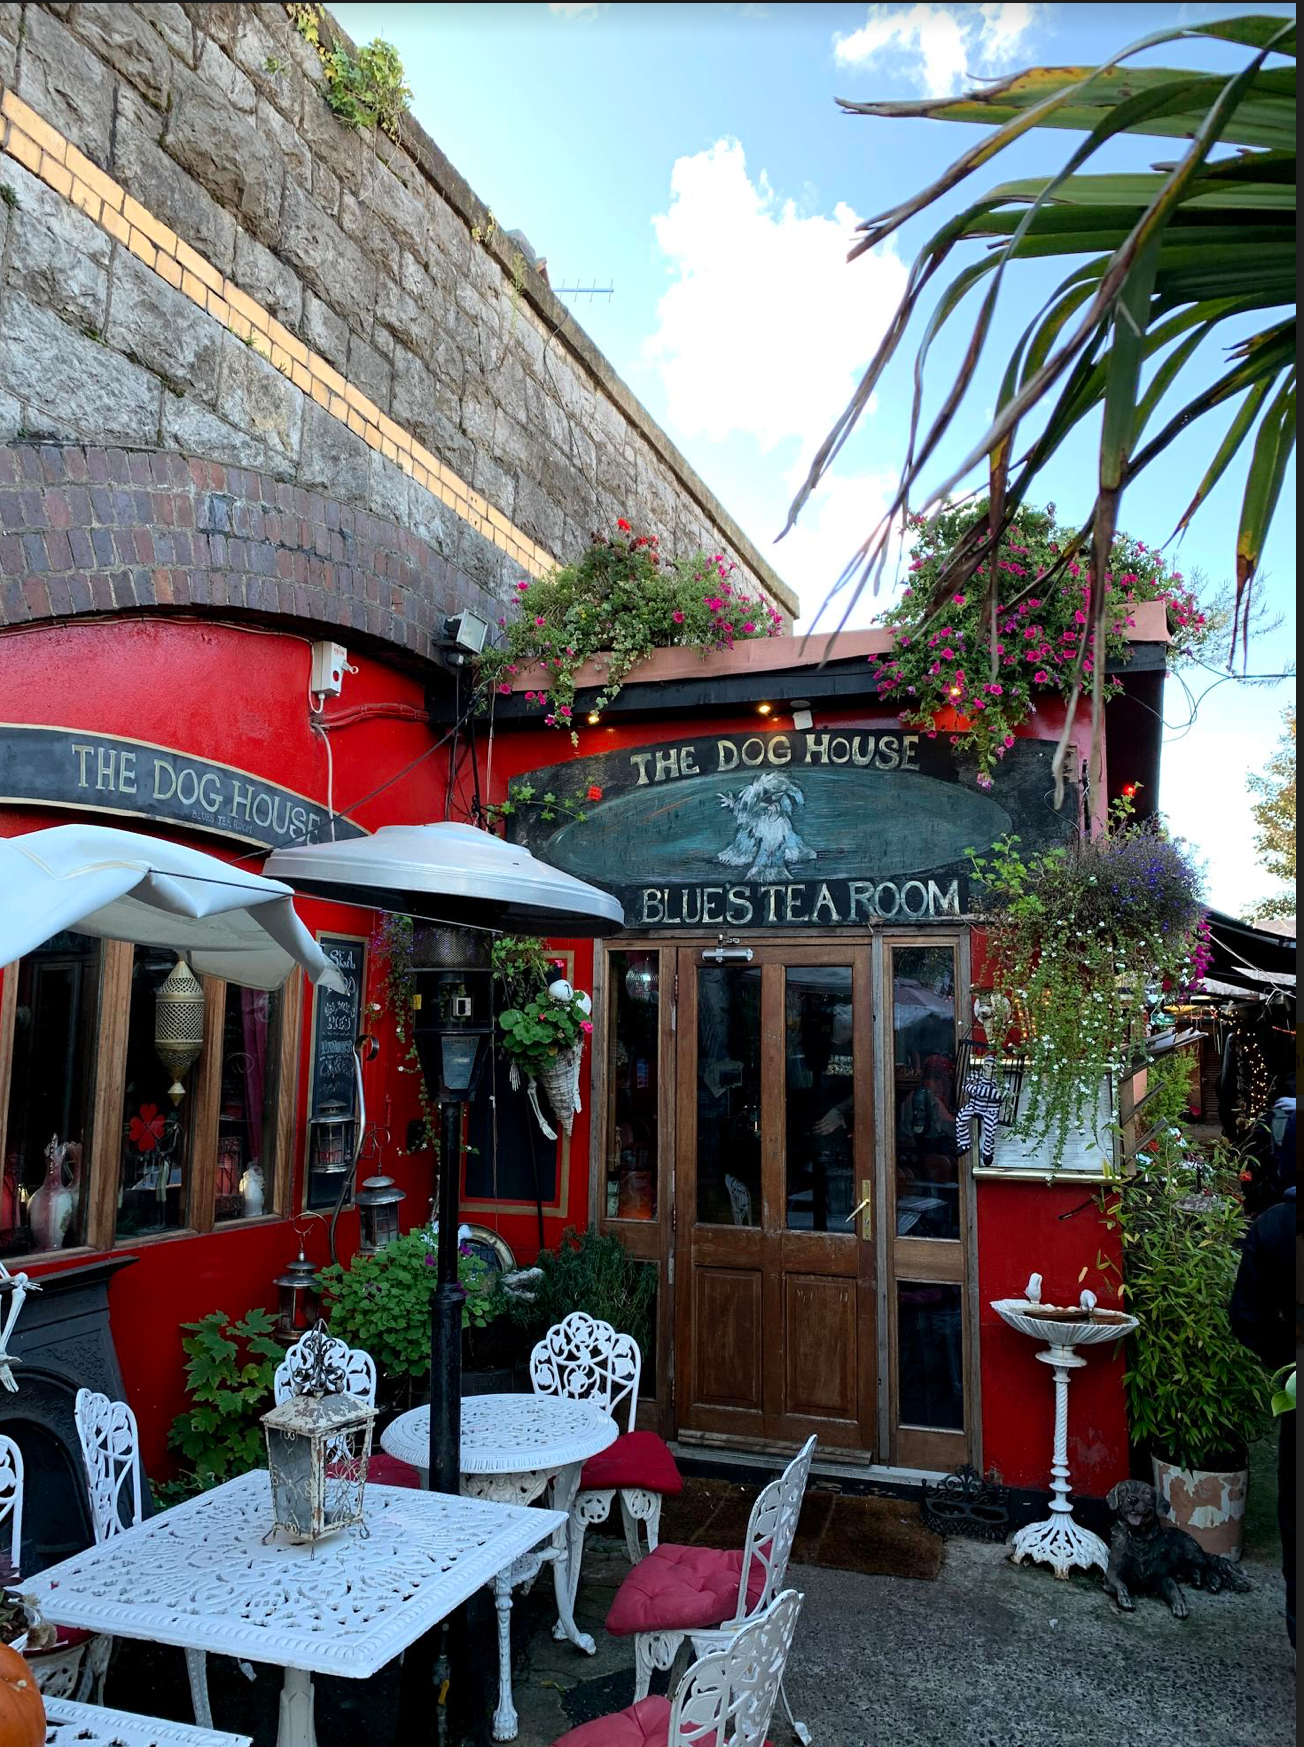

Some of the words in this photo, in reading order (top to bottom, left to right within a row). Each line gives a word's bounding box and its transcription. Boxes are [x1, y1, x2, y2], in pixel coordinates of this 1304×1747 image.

[630, 745, 700, 786] THE
[716, 735, 793, 772] DOG
[803, 733, 920, 771] HOUSE
[72, 745, 138, 794] THE
[153, 759, 223, 812] DOG
[230, 780, 322, 845] HOUSE
[760, 883, 842, 923] TEA
[849, 879, 962, 921] ROOM
